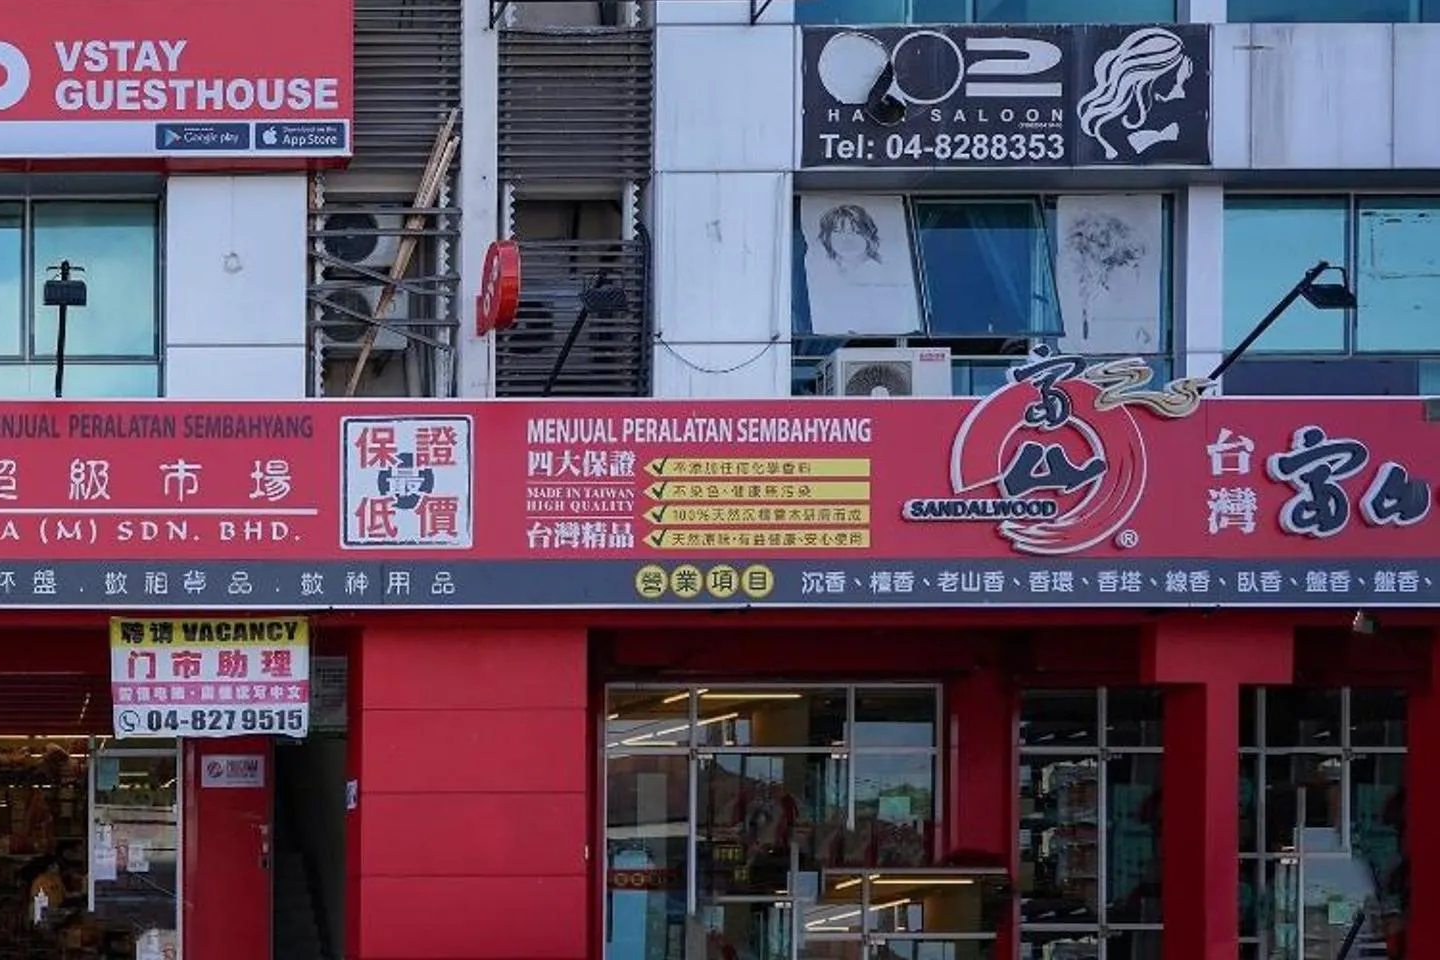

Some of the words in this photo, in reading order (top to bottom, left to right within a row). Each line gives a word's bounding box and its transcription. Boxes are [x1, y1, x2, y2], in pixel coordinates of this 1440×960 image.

[55, 40, 187, 72] VSTAY
[55, 78, 338, 110] GUESTHOUSE
[930, 108, 1063, 123] SALOON
[183, 132, 218, 145] Google
[220, 132, 240, 144] play
[282, 134, 304, 146] App
[307, 134, 337, 145] Store
[819, 134, 875, 159] Tel:
[885, 133, 1065, 160] 04-8288353
[67, 415, 177, 438] PERALATAN
[183, 415, 314, 439] SEMBAHYANG
[527, 419, 616, 444] MENJUAL
[622, 418, 731, 443] PERALATAN
[737, 417, 872, 442] SEMBAHYANG
[354, 427, 458, 469] 保證
[526, 450, 637, 478] 四大保證
[526, 486, 563, 499] MADE
[565, 486, 581, 498] IN
[583, 486, 635, 498] TAIWAN
[1206, 427, 1257, 535] 台灣
[354, 496, 459, 538] 低價
[526, 500, 566, 512] HIGH
[570, 500, 635, 513] QUALITY
[910, 500, 1057, 518] SANDALWOOD
[39, 518, 98, 544] (M)
[117, 519, 201, 542] SDN.
[219, 519, 302, 542] BHD.
[526, 522, 635, 549] 台灣精品
[182, 621, 298, 642] VACANCY
[127, 649, 293, 679] 门市助理
[146, 709, 237, 731] 04-827
[241, 708, 304, 731] 9515
